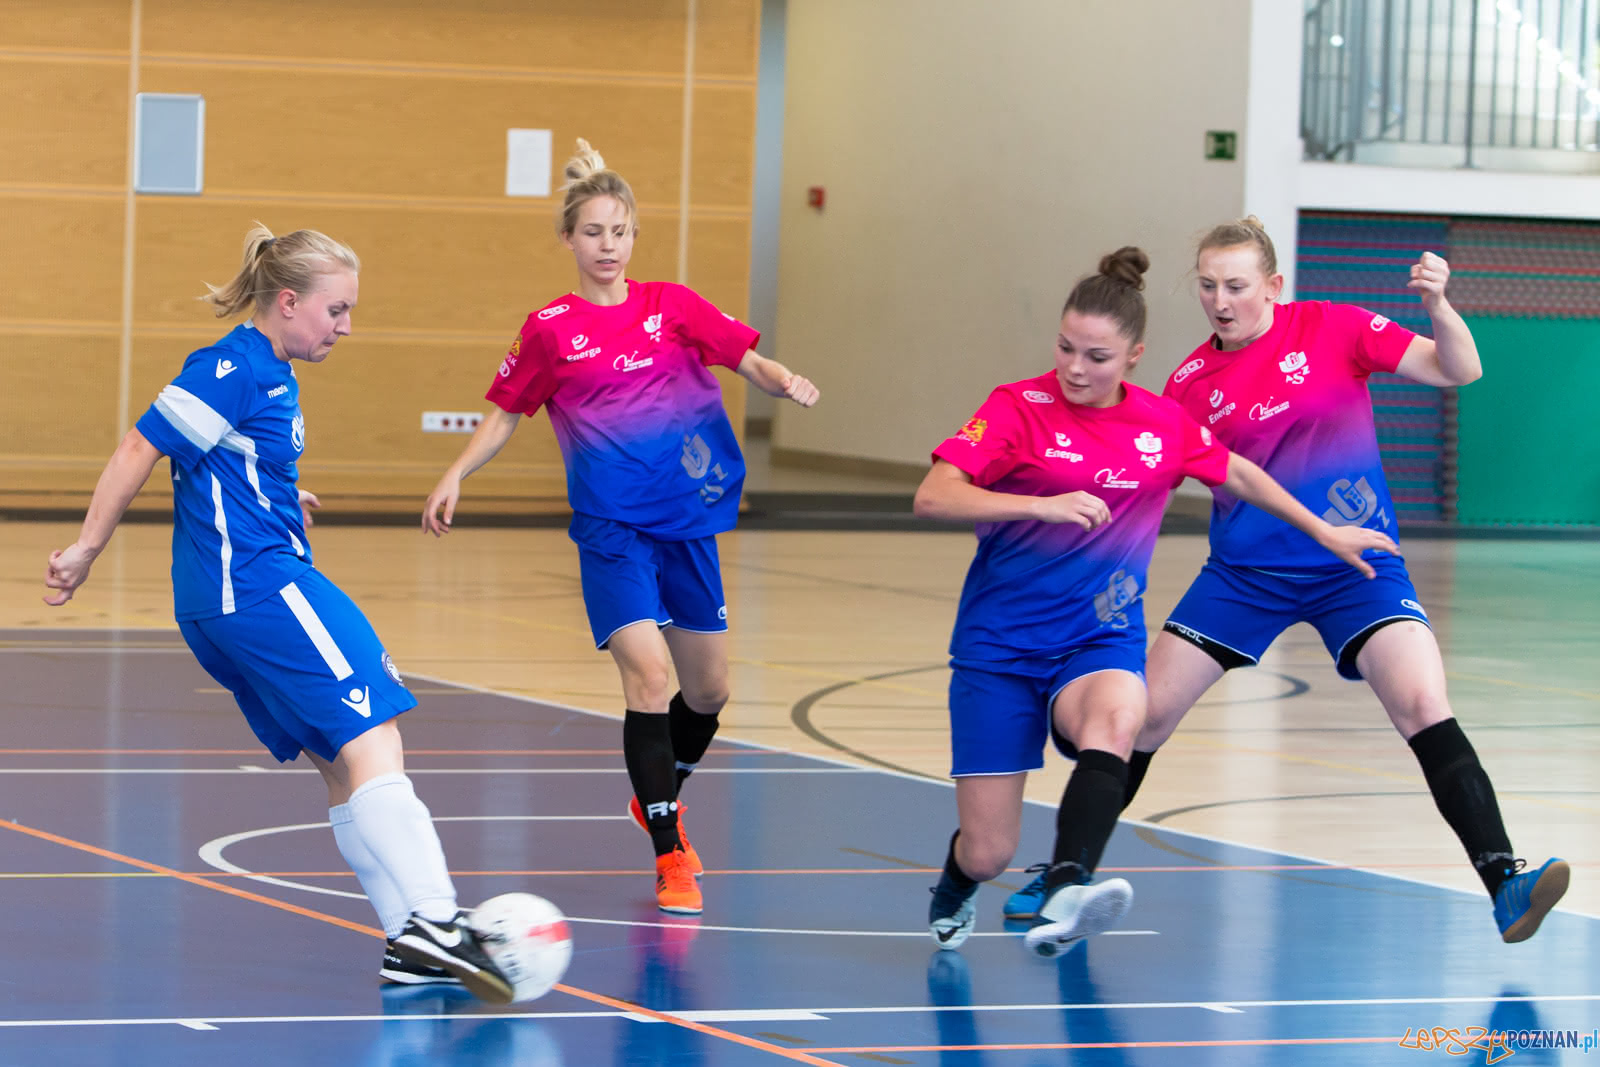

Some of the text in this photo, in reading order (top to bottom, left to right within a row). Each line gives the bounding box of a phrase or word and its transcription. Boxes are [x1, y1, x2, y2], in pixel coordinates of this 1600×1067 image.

[566, 346, 602, 363] Energa
[1208, 402, 1236, 424] Energa
[1045, 448, 1084, 463] Energa
